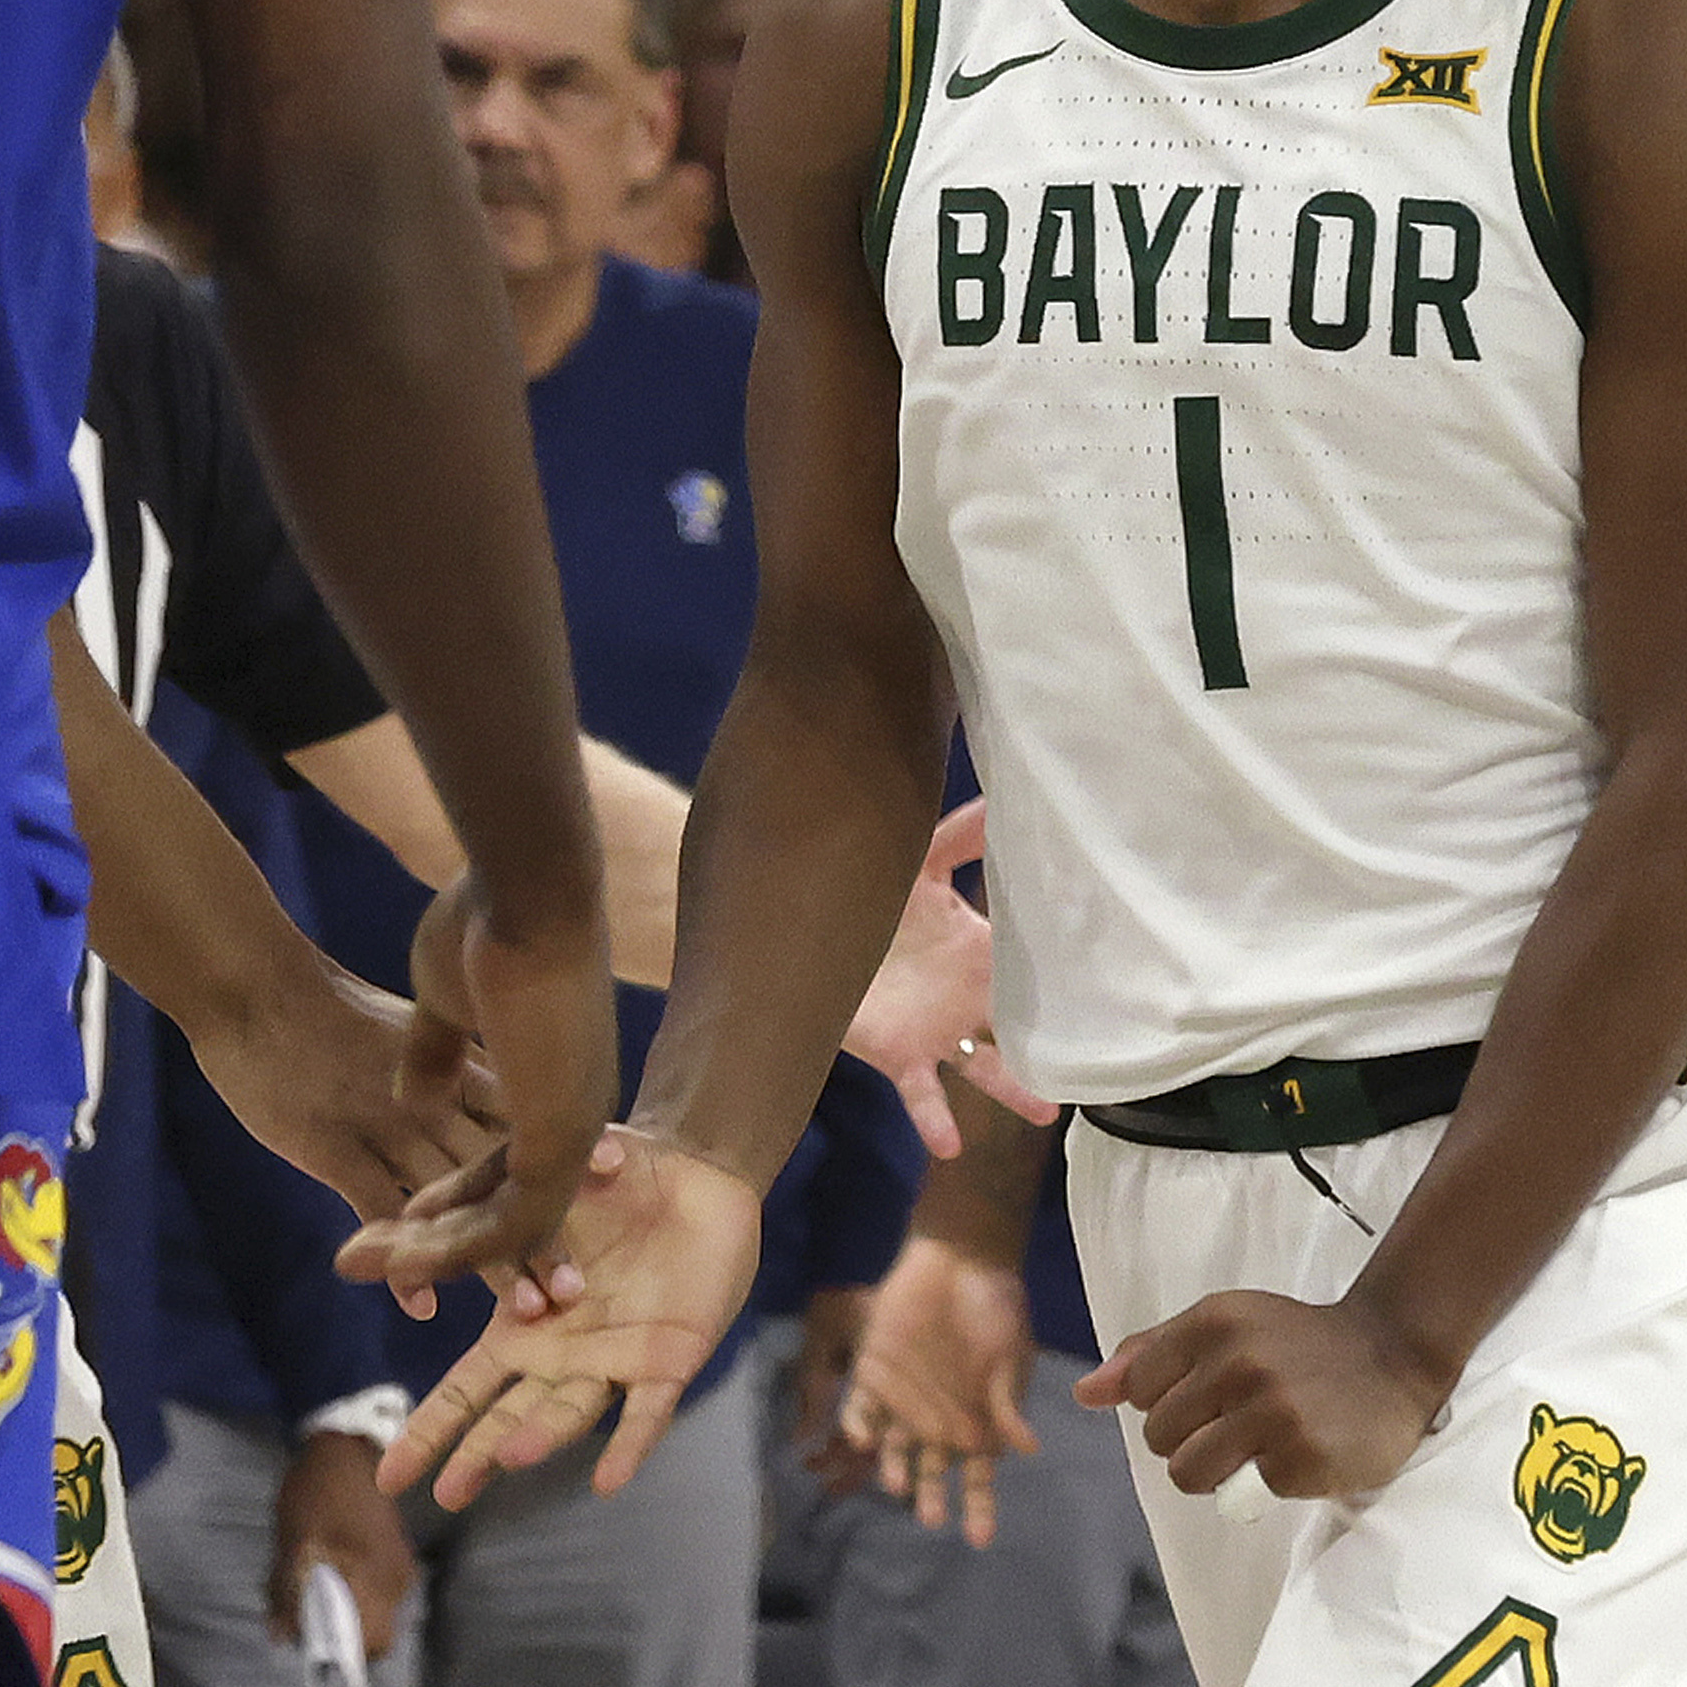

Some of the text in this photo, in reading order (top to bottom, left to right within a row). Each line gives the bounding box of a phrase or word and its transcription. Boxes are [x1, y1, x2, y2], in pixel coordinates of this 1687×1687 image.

[1375, 48, 1481, 106] XII
[938, 184, 1482, 361] BAYLOR
[1172, 395, 1251, 692] 1
